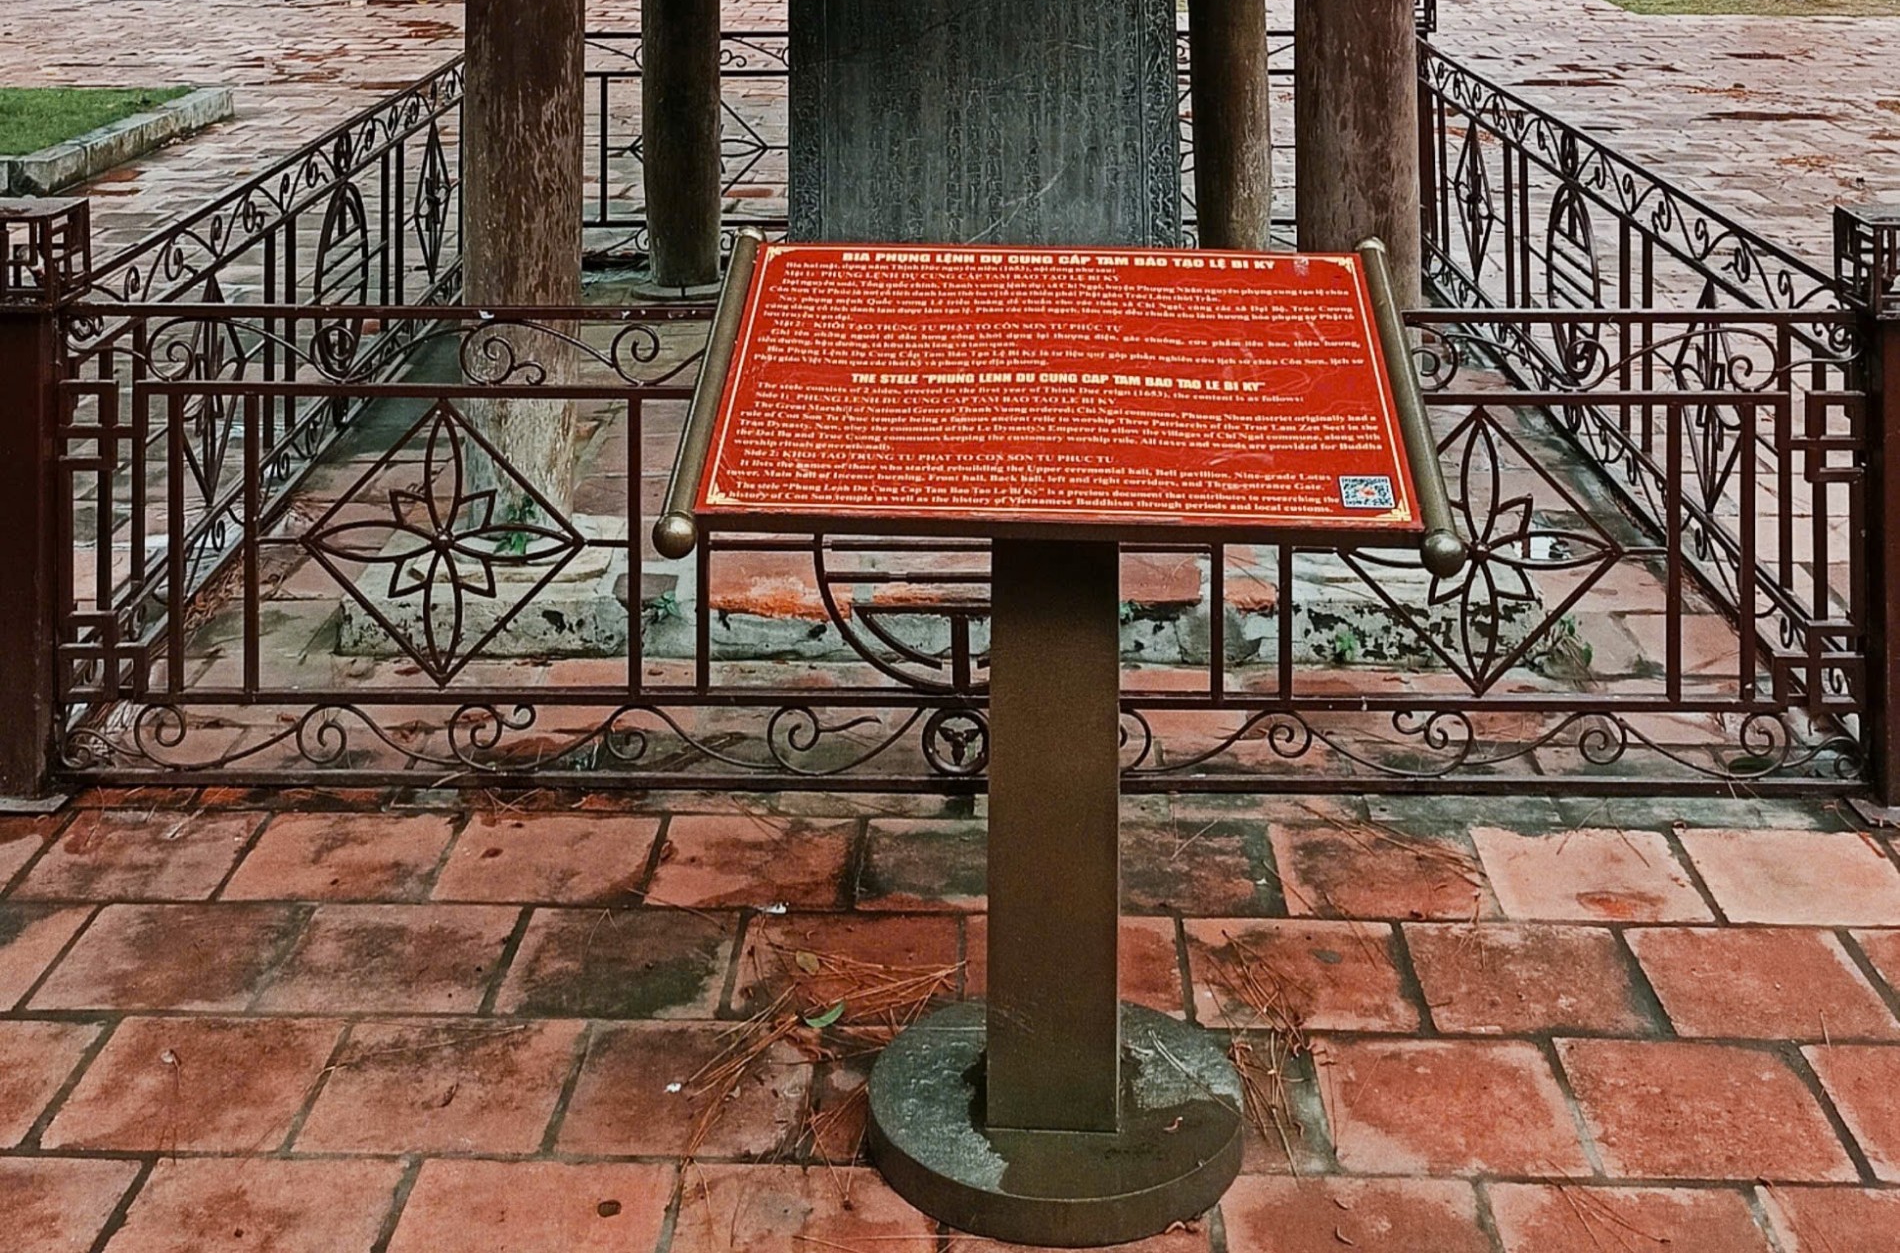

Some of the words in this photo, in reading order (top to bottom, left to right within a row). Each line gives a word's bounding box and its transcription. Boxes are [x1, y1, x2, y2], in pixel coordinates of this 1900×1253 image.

[842, 252, 870, 261] BIA
[874, 252, 930, 263] PHỤNG
[979, 254, 1003, 265] DỤ
[1007, 254, 1053, 264] CUNG
[1095, 256, 1129, 266] TAM
[1172, 257, 1204, 268] TẠO
[1230, 259, 1249, 268] BI
[851, 373, 876, 383] THE
[879, 374, 918, 384] STELE
[978, 372, 1012, 383] LENH
[1015, 372, 1035, 382] DU
[1039, 372, 1077, 383] CUNG
[1081, 373, 1109, 384] CAP
[1112, 374, 1141, 385] TAM
[1144, 376, 1173, 388] BAO
[1175, 378, 1201, 389] TAO
[1205, 380, 1220, 390] LE
[1223, 380, 1239, 391] BI
